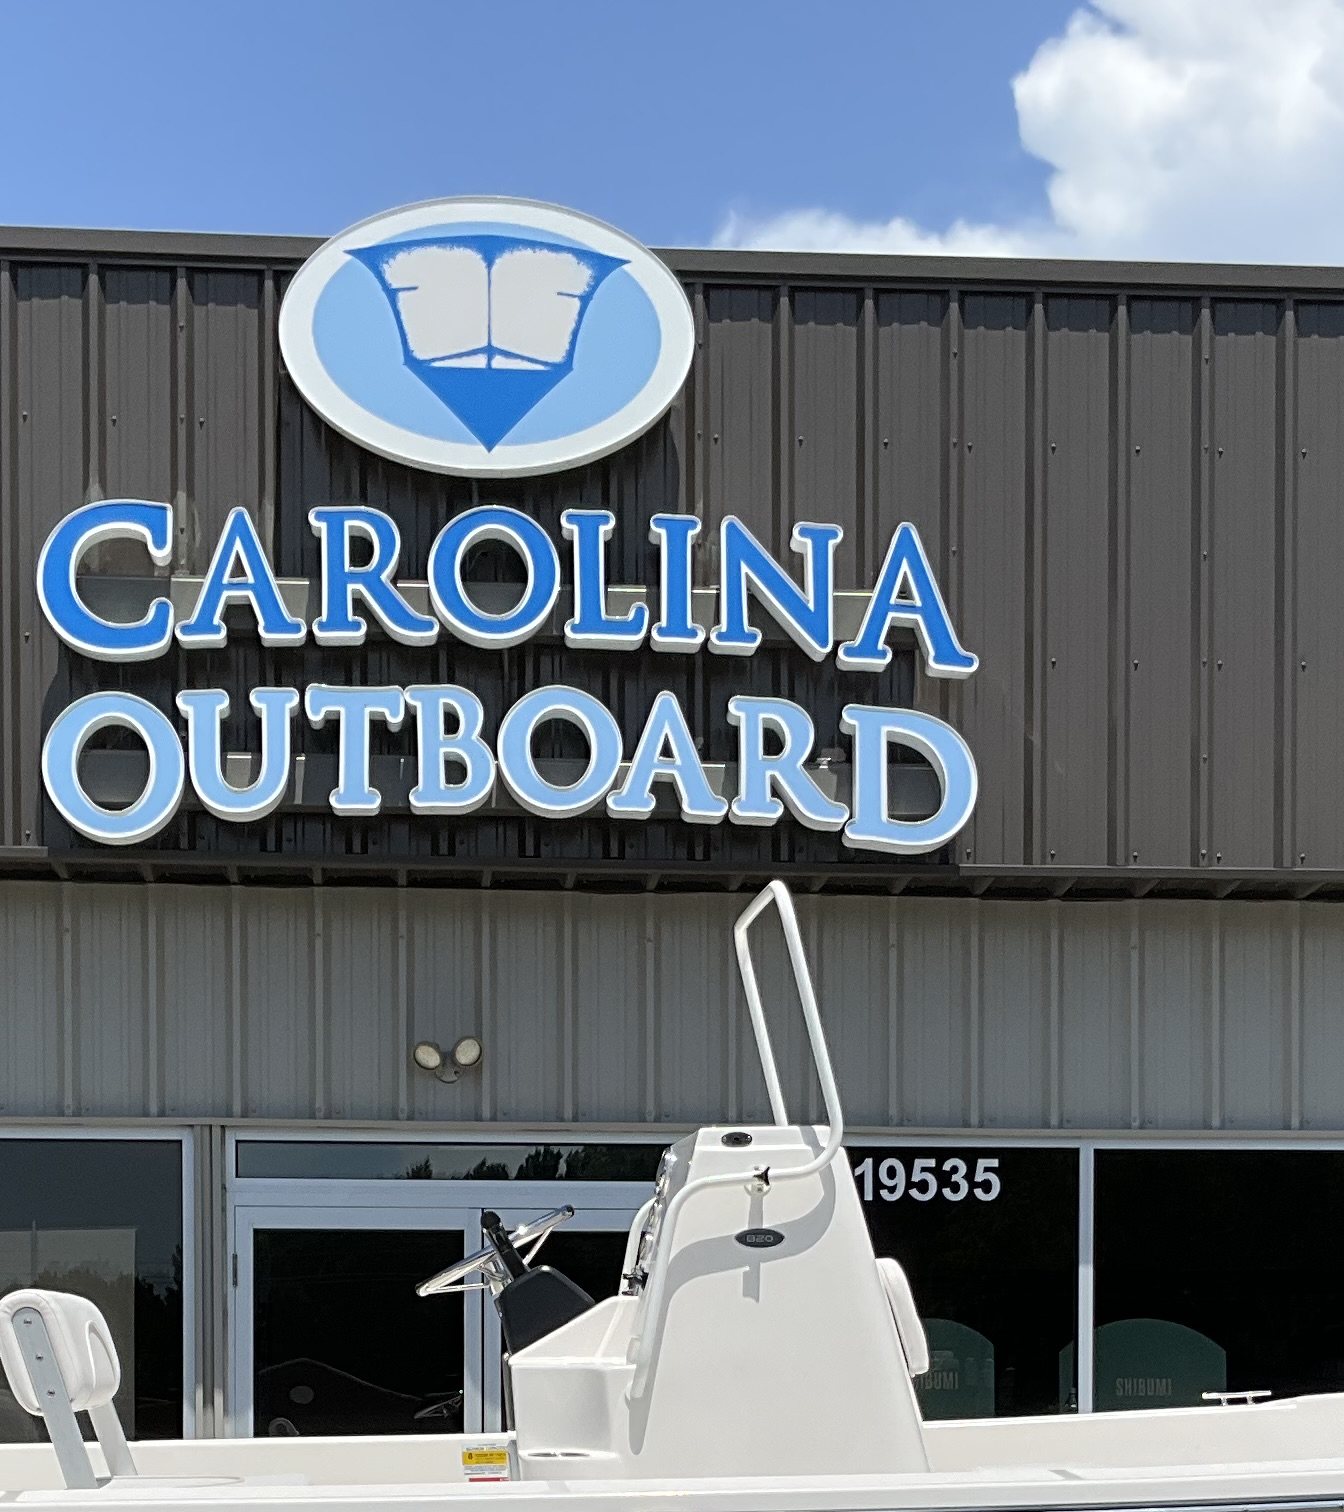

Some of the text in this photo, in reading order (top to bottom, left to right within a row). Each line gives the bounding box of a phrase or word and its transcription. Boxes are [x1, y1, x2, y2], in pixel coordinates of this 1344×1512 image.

[36, 499, 980, 679] CAROLINA
[41, 685, 978, 854] OUTBOARD
[854, 1156, 1001, 1202] 19535
[912, 1370, 959, 1390] IBUMI
[1115, 1377, 1173, 1396] SHIBUMI
